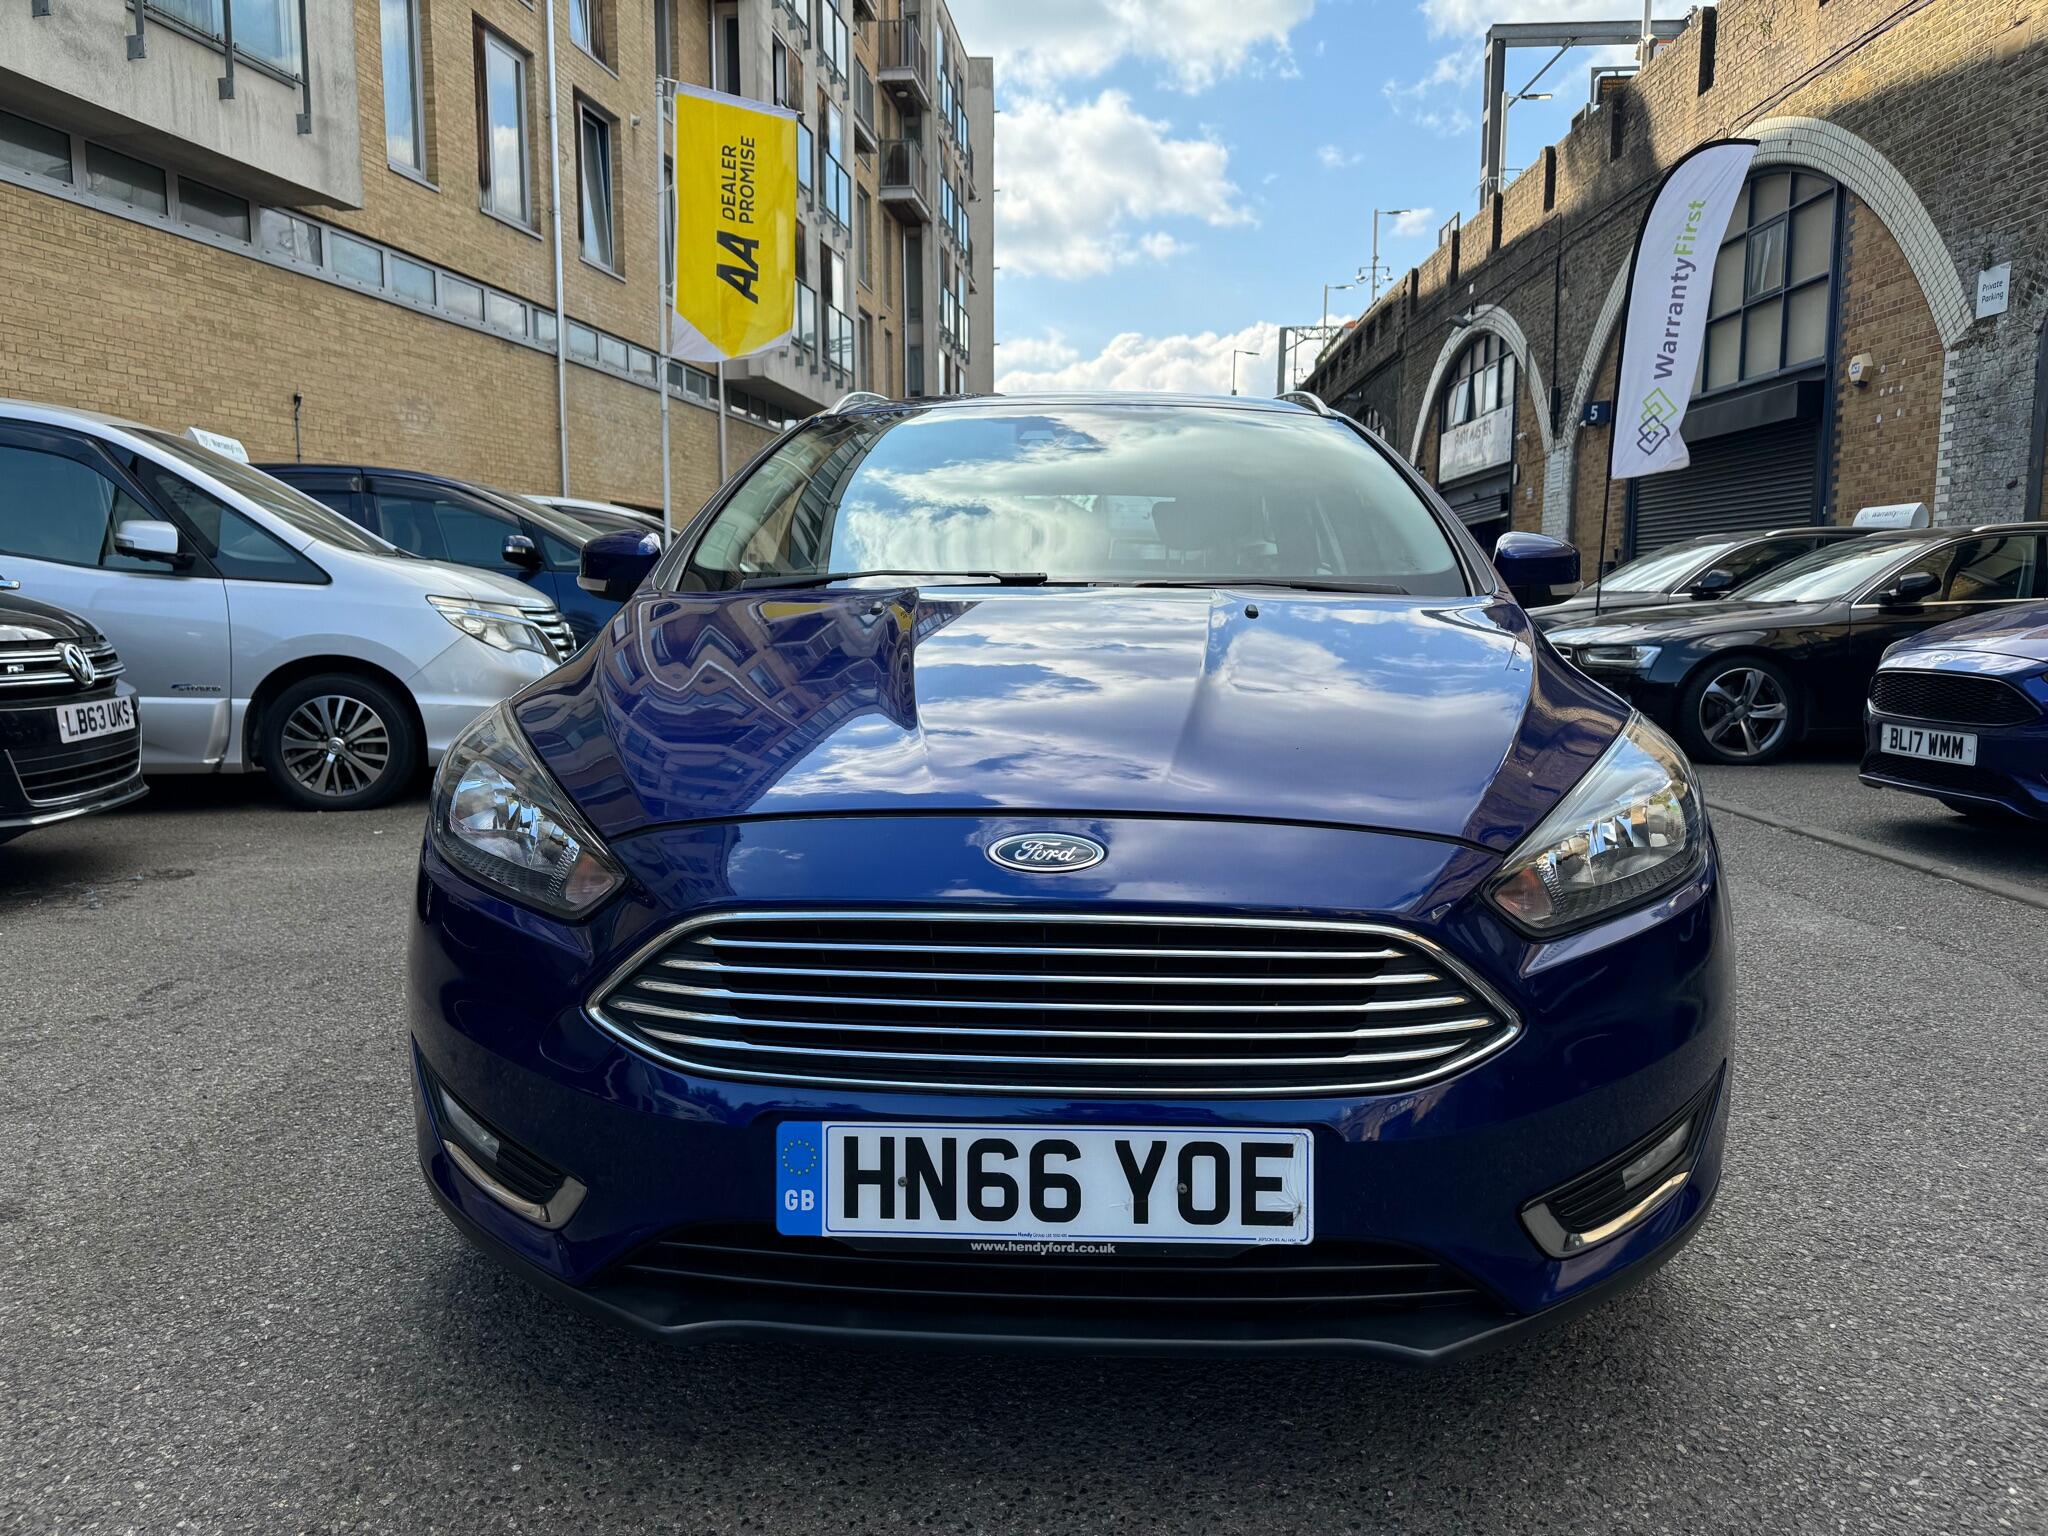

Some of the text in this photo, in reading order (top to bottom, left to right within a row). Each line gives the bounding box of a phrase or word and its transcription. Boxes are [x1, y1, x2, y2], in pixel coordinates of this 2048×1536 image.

[721, 144, 737, 221] DEALER
[739, 135, 755, 224] PROMISE
[716, 230, 760, 305] AA
[1654, 199, 1707, 380] WarrantyFirst
[1981, 291, 2004, 304] Parking
[1982, 280, 2003, 292] Private
[1590, 405, 1598, 420] 5
[64, 700, 130, 737] LB63 UKS
[1889, 727, 1964, 760] BL17 WMM
[1014, 840, 1077, 862] Ford
[843, 1135, 1294, 1227] HN66 YOE
[784, 1189, 815, 1211] GB
[970, 1241, 1116, 1256] www.hendyford.co.uk
